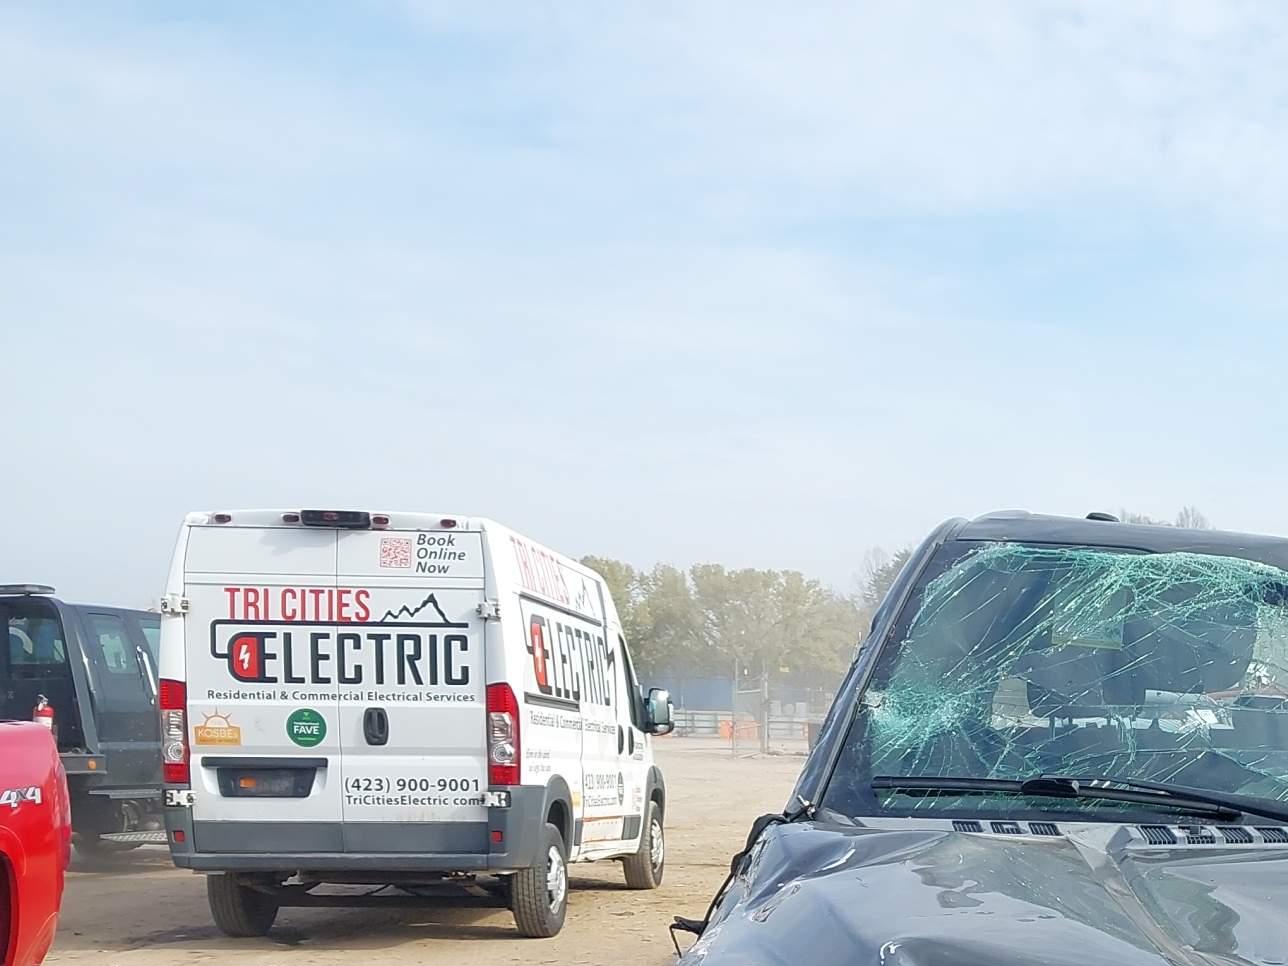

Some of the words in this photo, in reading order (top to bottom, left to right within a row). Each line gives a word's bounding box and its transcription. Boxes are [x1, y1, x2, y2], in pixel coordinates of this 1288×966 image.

[416, 533, 456, 546] Book
[416, 548, 466, 561] Online
[415, 561, 450, 574] Now
[224, 587, 269, 621] TRI
[280, 588, 371, 623] CITIES
[227, 631, 470, 686] ELECTRIC
[207, 689, 276, 700] Residential
[280, 690, 288, 700] &
[292, 690, 363, 701] Commercial
[367, 691, 422, 702] Electrical
[426, 691, 475, 702] Services
[293, 725, 320, 735] FAVE
[344, 777, 390, 794] (423)
[396, 778, 479, 792] 900-9001
[345, 794, 480, 806] TriCitiesElectriccom
